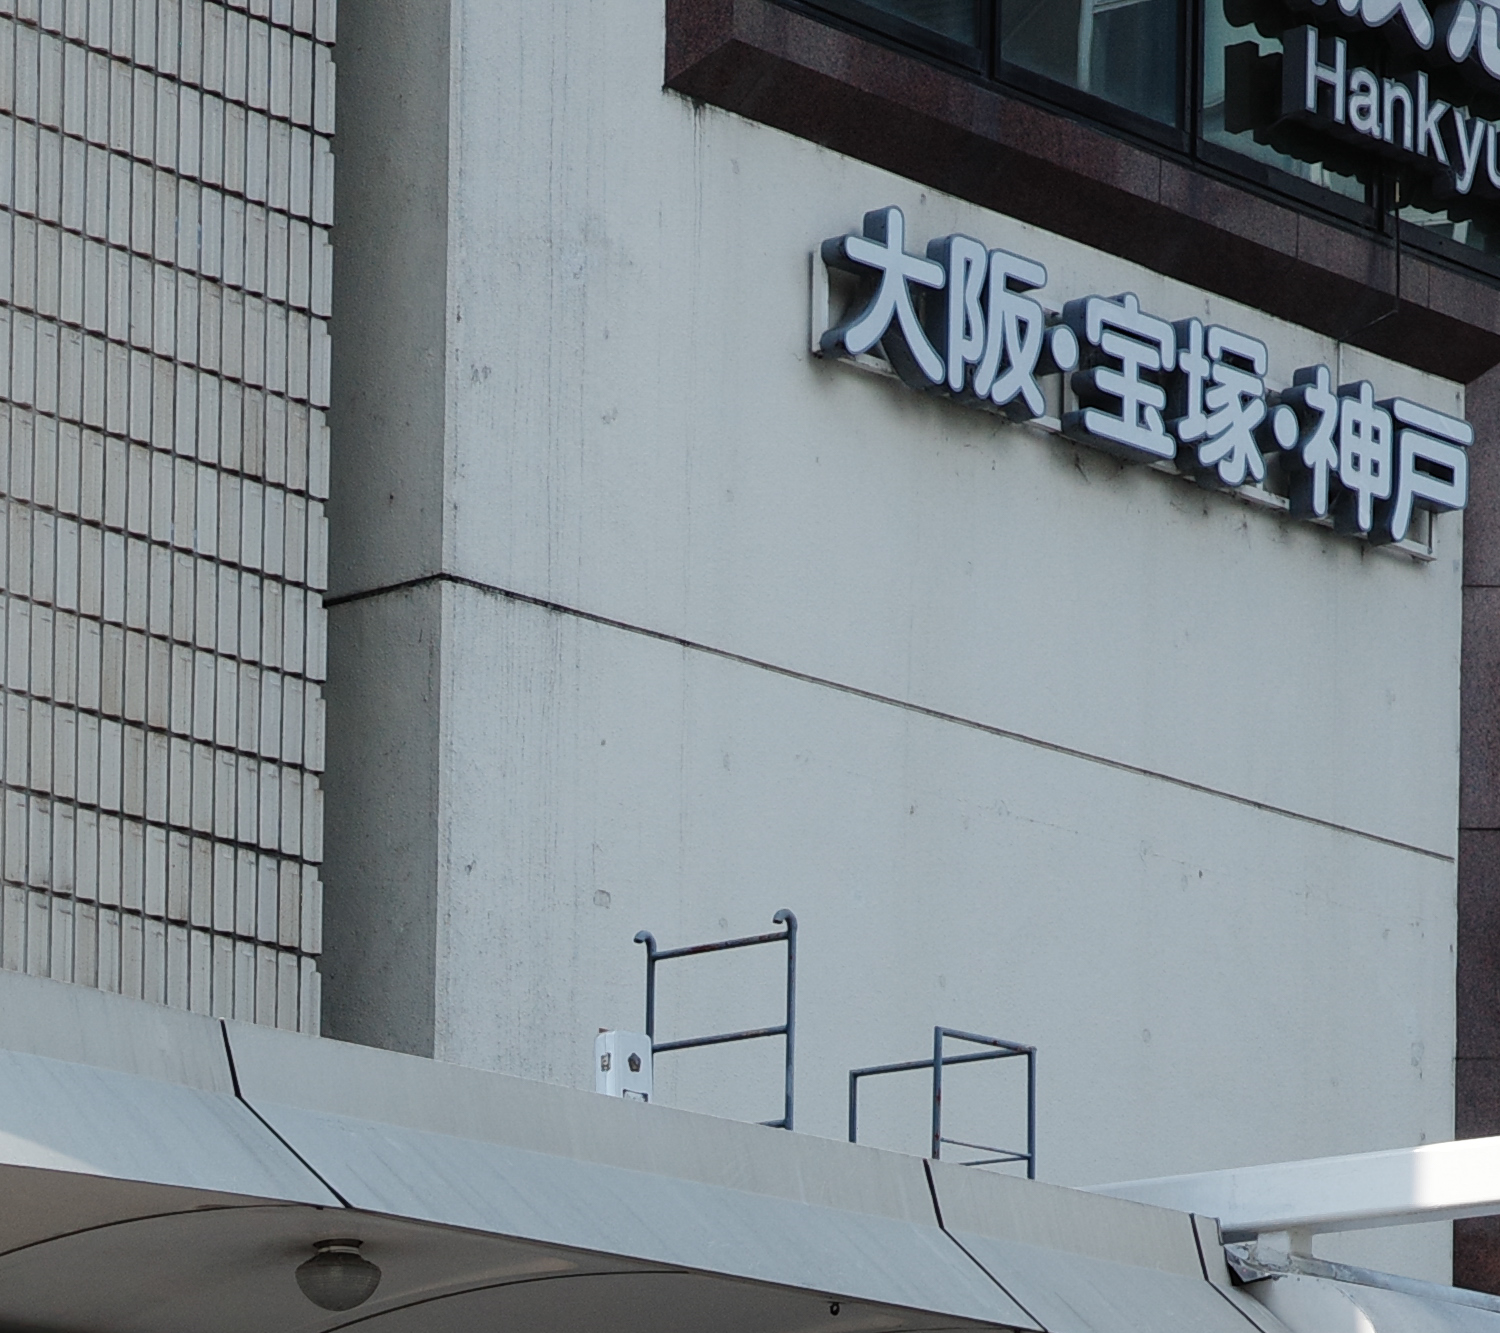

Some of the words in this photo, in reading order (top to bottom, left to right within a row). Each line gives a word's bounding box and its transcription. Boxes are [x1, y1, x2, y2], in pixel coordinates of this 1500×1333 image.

[840, 205, 1475, 544] 大阪・宝塚・神戸
